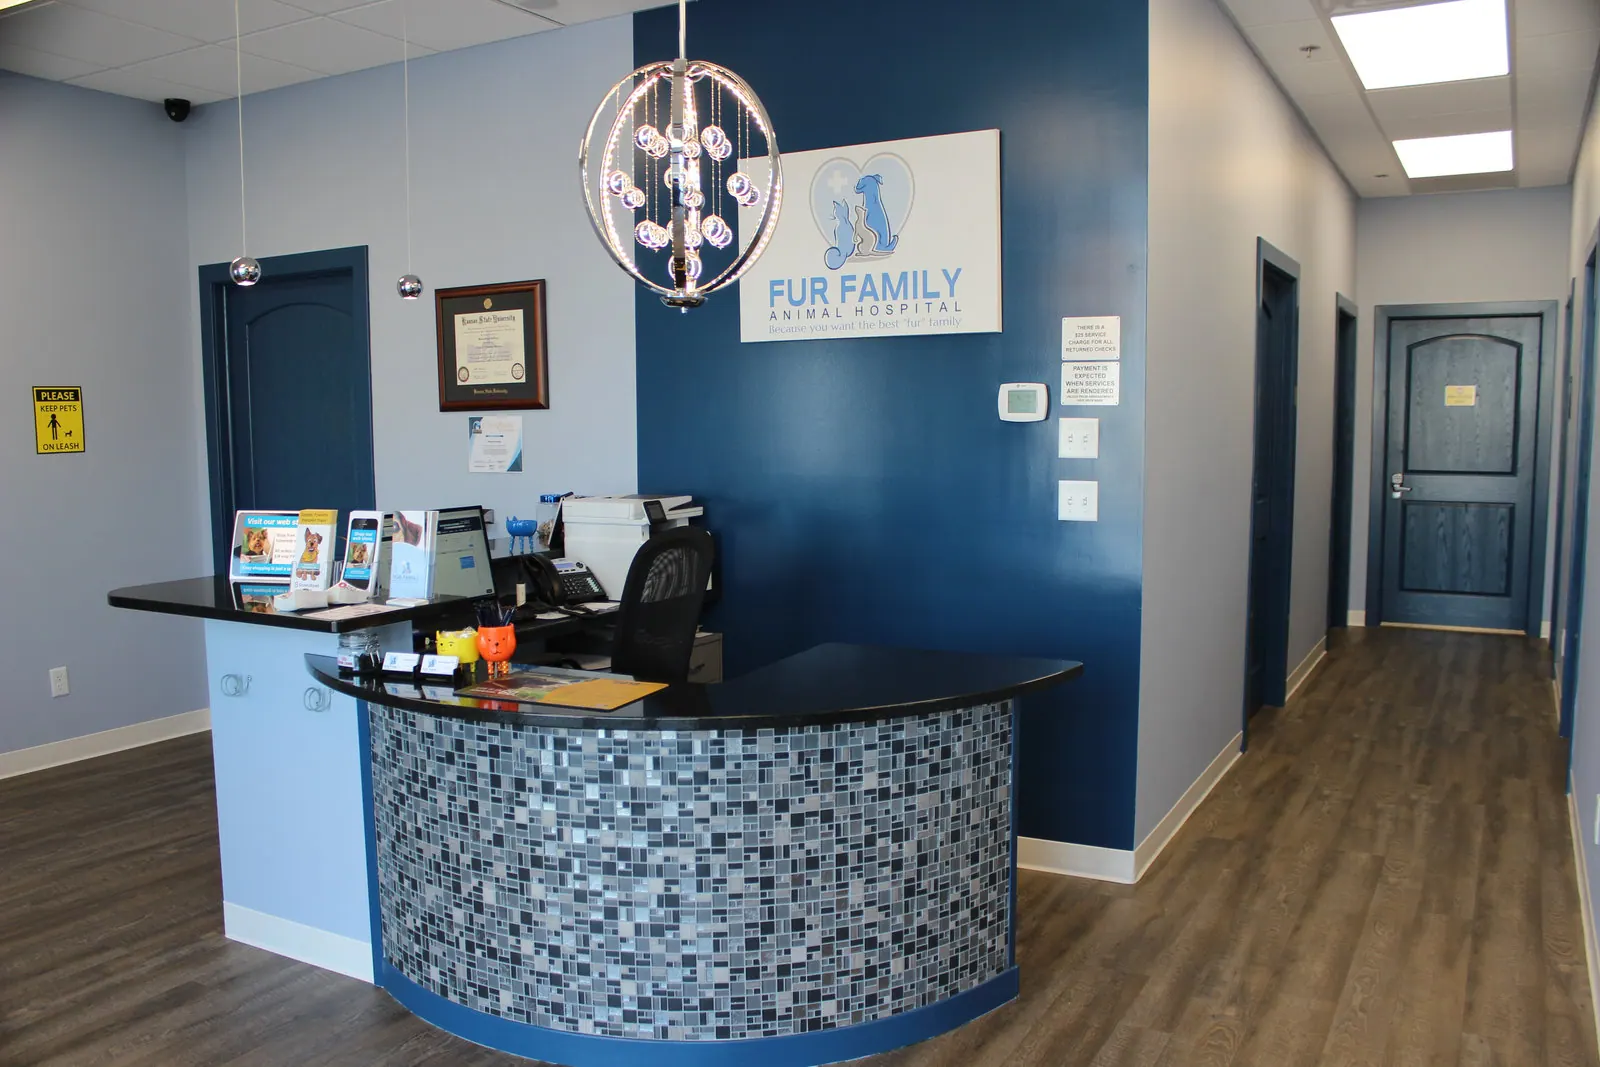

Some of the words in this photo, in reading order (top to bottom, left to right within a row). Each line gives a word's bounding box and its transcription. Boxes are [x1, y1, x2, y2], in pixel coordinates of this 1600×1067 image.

[769, 276, 829, 308] FUR
[840, 267, 963, 304] FAMILY
[769, 307, 843, 321] ANIMAL
[855, 301, 962, 317] HOSPITAL
[769, 323, 807, 335] Because
[809, 323, 828, 334] you
[829, 321, 855, 332] want
[858, 319, 876, 330] the
[878, 318, 899, 329] best
[903, 316, 926, 328] "fur"
[929, 315, 962, 328] family
[41, 391, 75, 401] PLEASE
[59, 404, 78, 412] PETS
[42, 443, 55, 451] ON
[56, 442, 80, 450] LEASH
[247, 517, 263, 525] Visit
[276, 518, 291, 526] web
